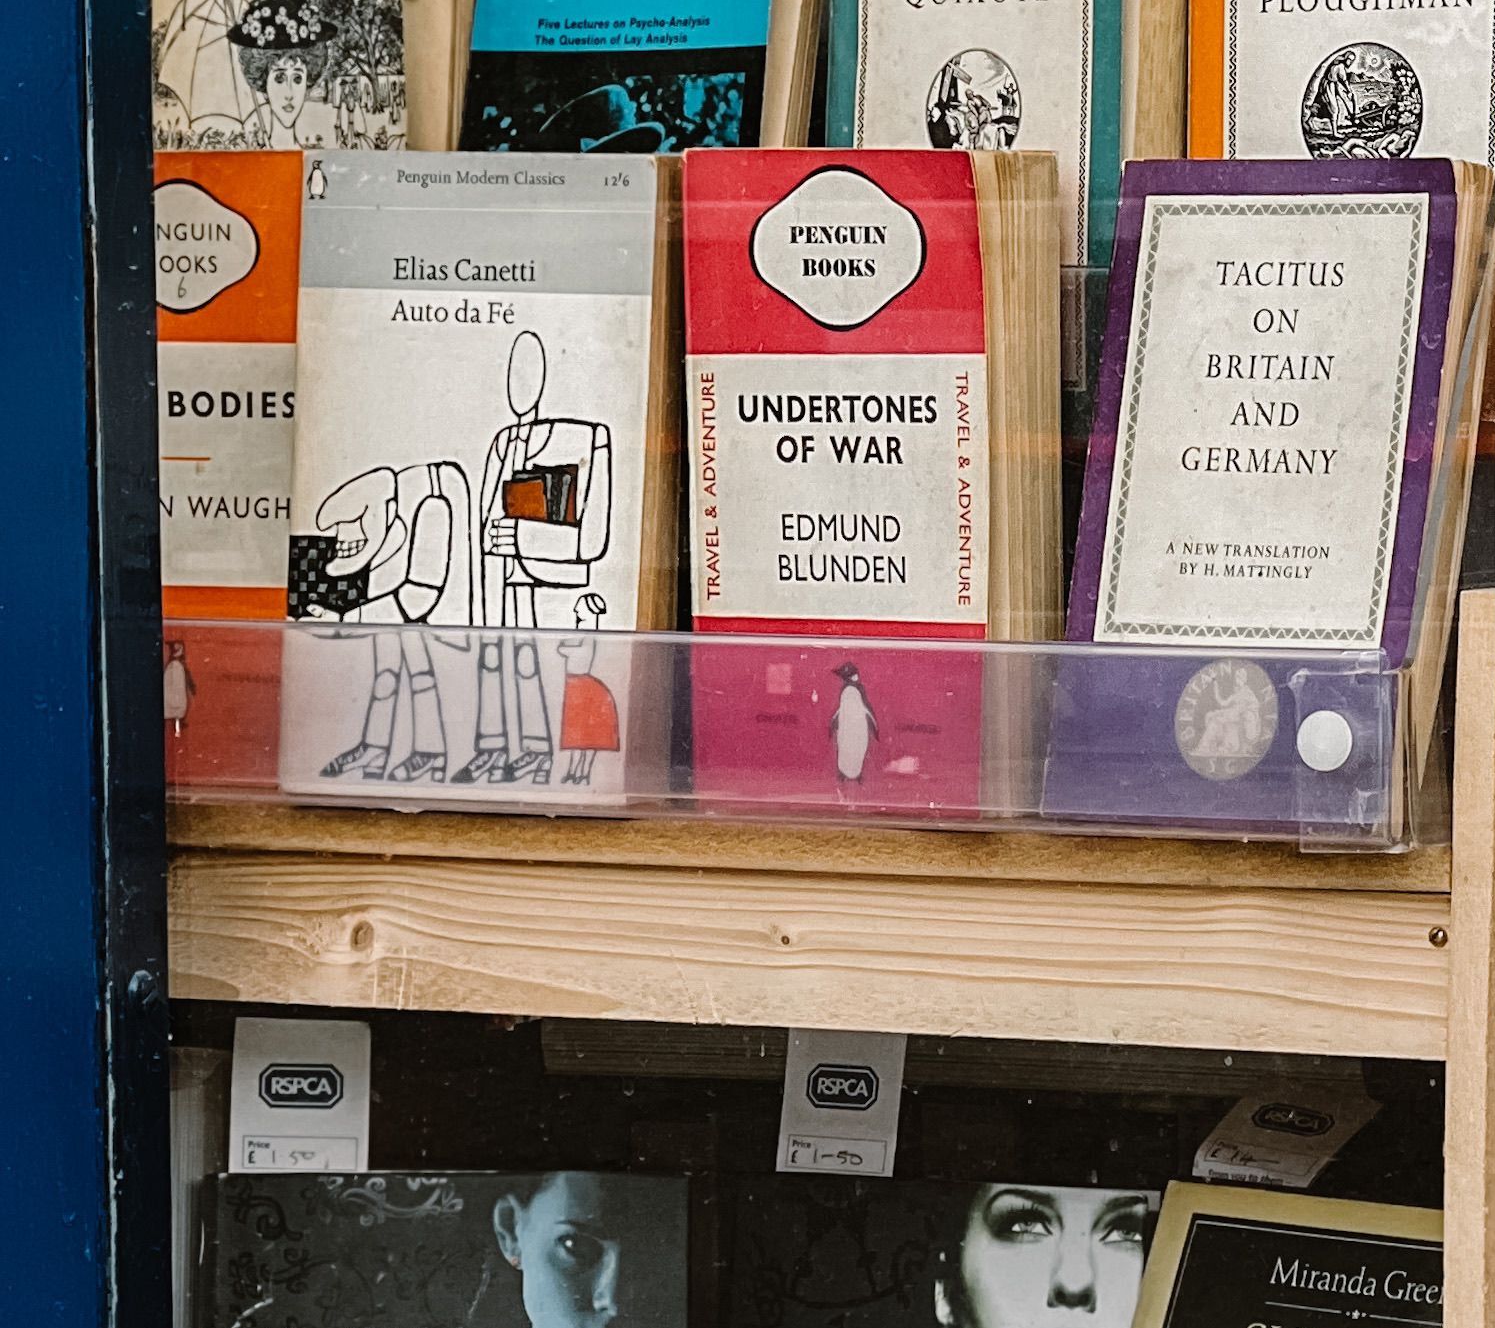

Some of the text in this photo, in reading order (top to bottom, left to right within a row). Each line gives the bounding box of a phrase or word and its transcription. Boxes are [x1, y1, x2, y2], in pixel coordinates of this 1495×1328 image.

[396, 169, 565, 188] Penguin Modern Classics
[789, 225, 887, 245] PENGUIN
[393, 257, 536, 282] Elias Canetti
[802, 258, 876, 277] BOOKS
[1215, 260, 1345, 288] TACITUS
[391, 299, 515, 324] Auto da Fé
[1252, 309, 1298, 334] ON
[1205, 354, 1335, 381] BRITAIN
[167, 391, 295, 418] BODIES
[738, 394, 937, 425] UNDERTONES
[1230, 402, 1300, 428] AND
[776, 435, 903, 465] OF WAR
[1181, 447, 1338, 476] GERMANY
[781, 513, 900, 543] EDMUND
[1165, 542, 1330, 560] A NEW TRANSLATION
[778, 555, 906, 584] BLUNDEN
[1179, 562, 1313, 580] BY H. MATTINGLY
[1269, 1256, 1376, 1298] Miranda
